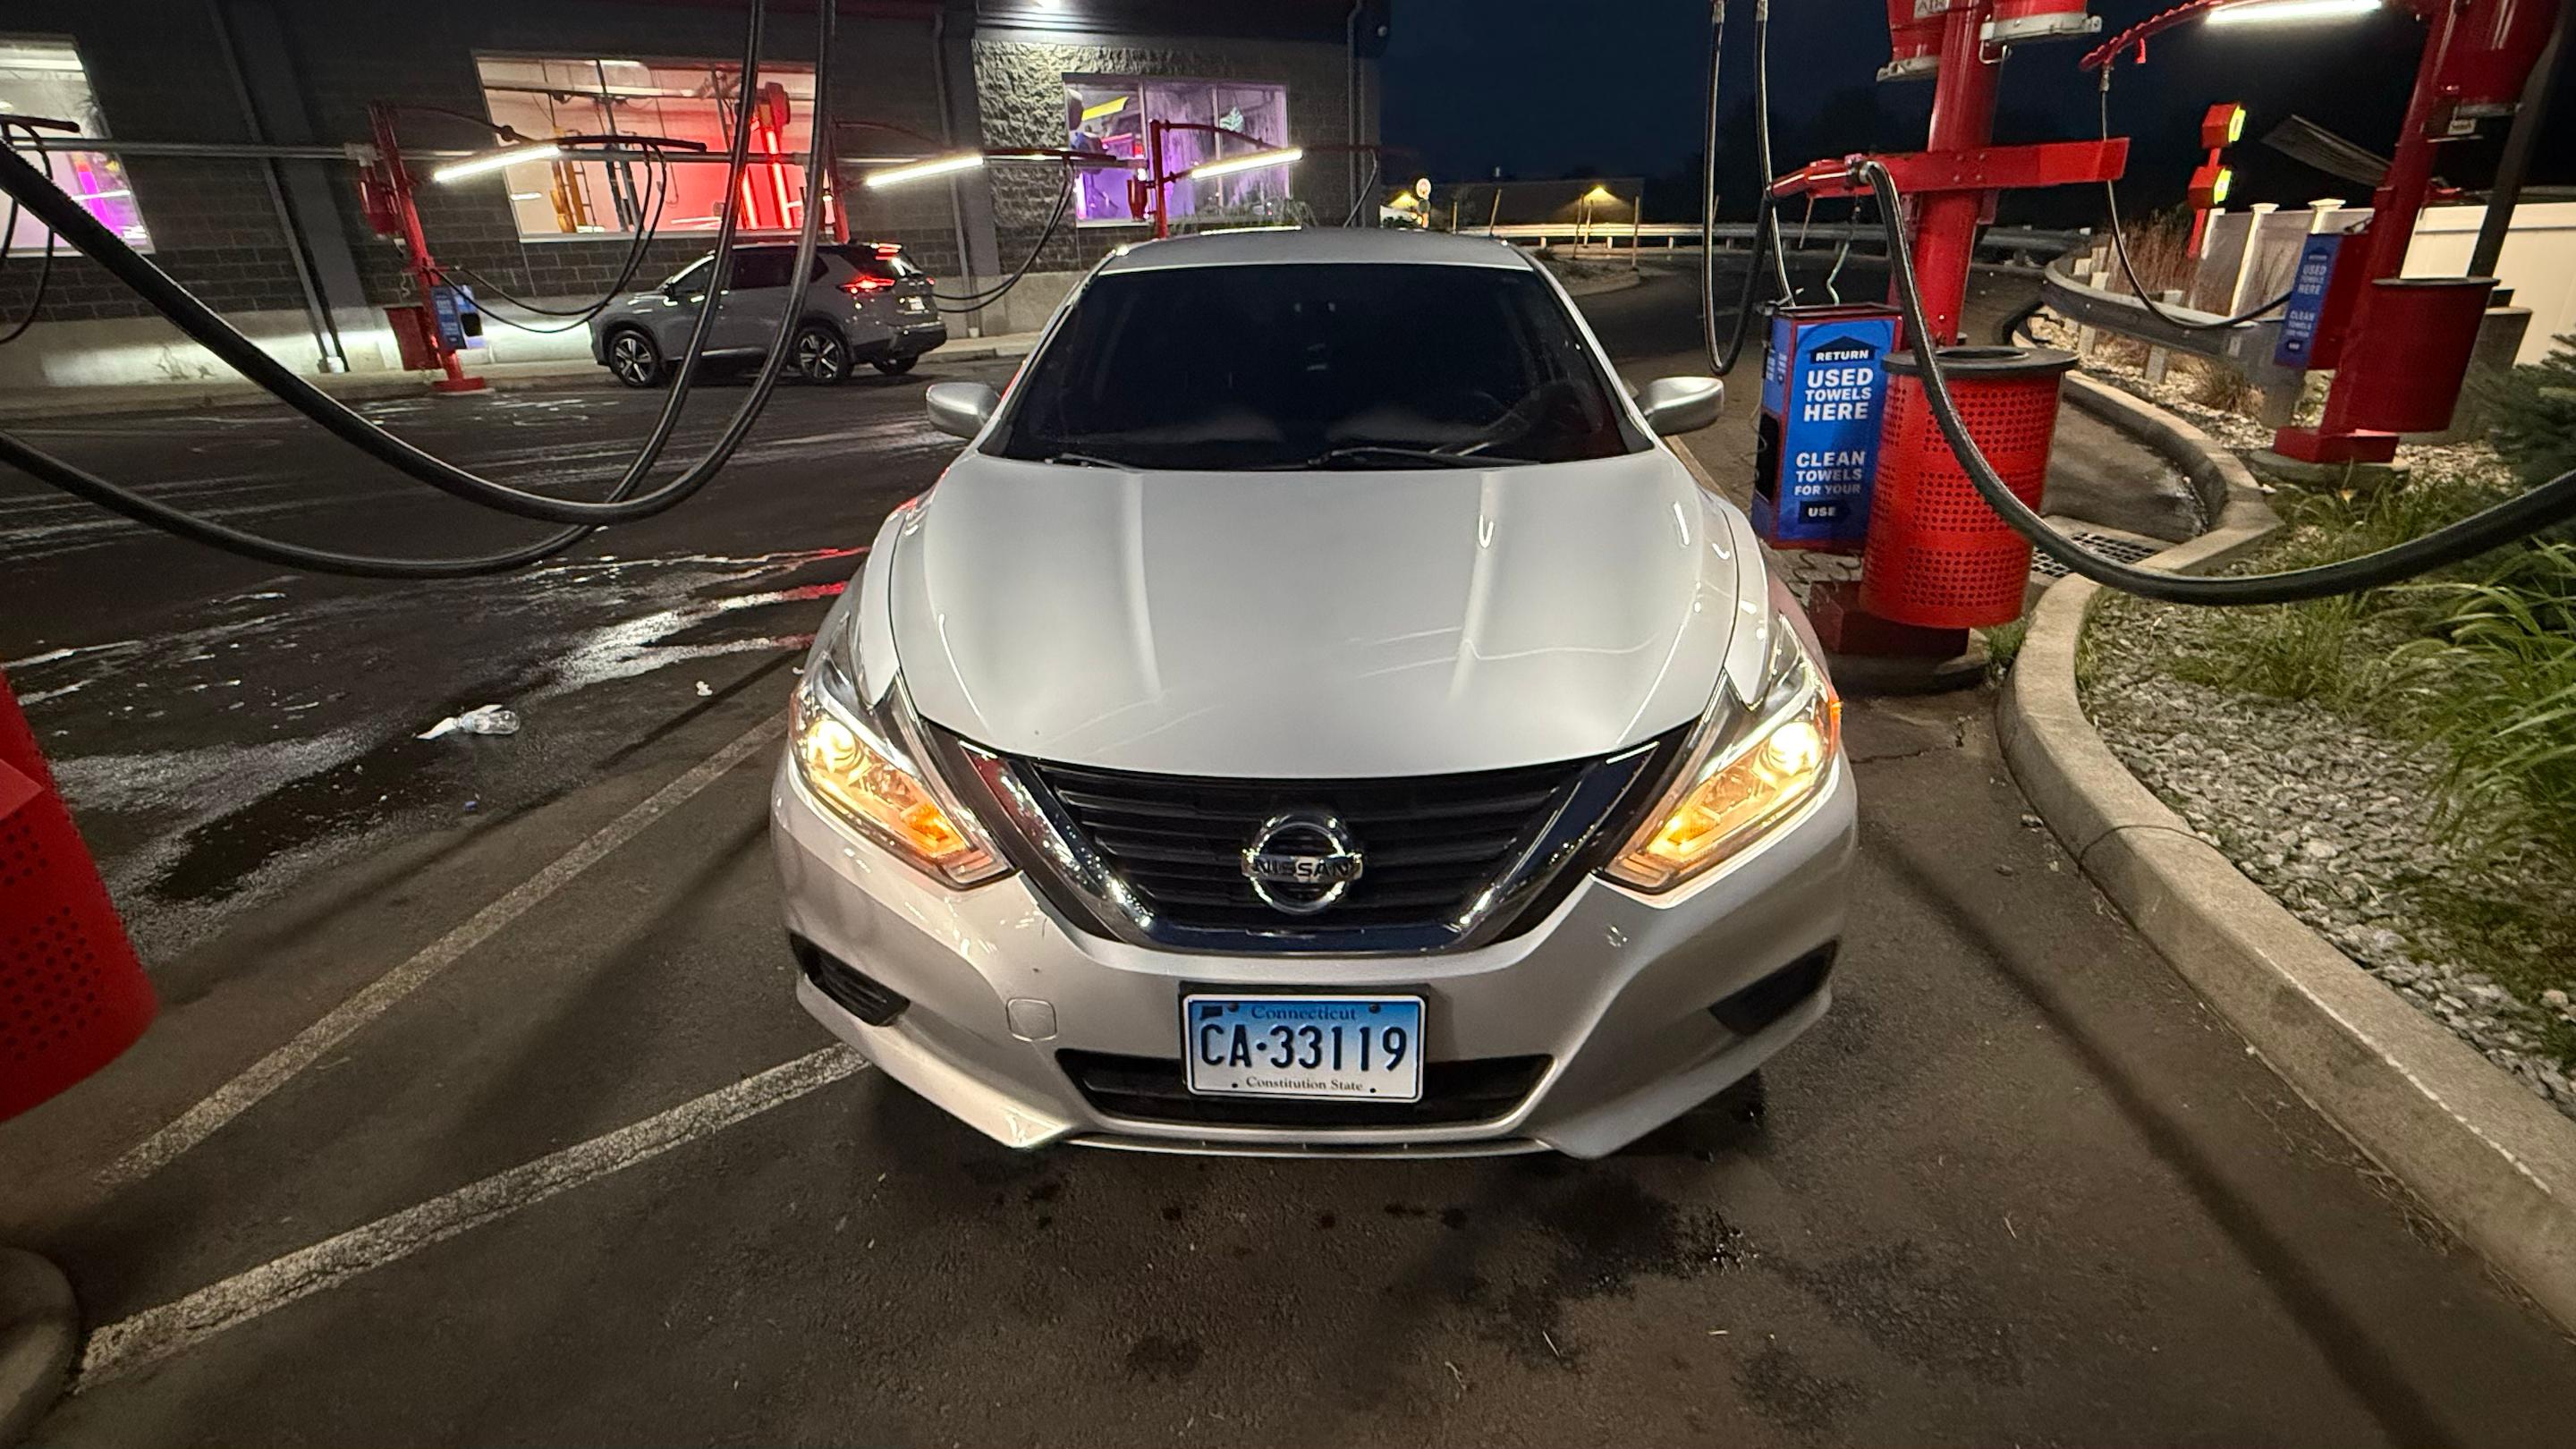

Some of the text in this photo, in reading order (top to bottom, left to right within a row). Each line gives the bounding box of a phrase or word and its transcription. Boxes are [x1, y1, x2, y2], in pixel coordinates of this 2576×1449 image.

[2302, 265, 2326, 275] USED
[2298, 284, 2321, 295] HERE
[1815, 350, 1868, 361] RETURN
[1807, 368, 1874, 388] USED
[1805, 386, 1872, 402] TOWELS
[1803, 402, 1869, 422] HERE
[1795, 451, 1866, 468] CLEAN
[1796, 468, 1863, 483] TOWELS
[1794, 483, 1861, 496] FOR YOUR
[1808, 507, 1836, 518] USE
[1256, 858, 1350, 877] NISSAN
[1251, 1005, 1357, 1021] Connecticut
[1245, 1077, 1363, 1092] Constitution State
